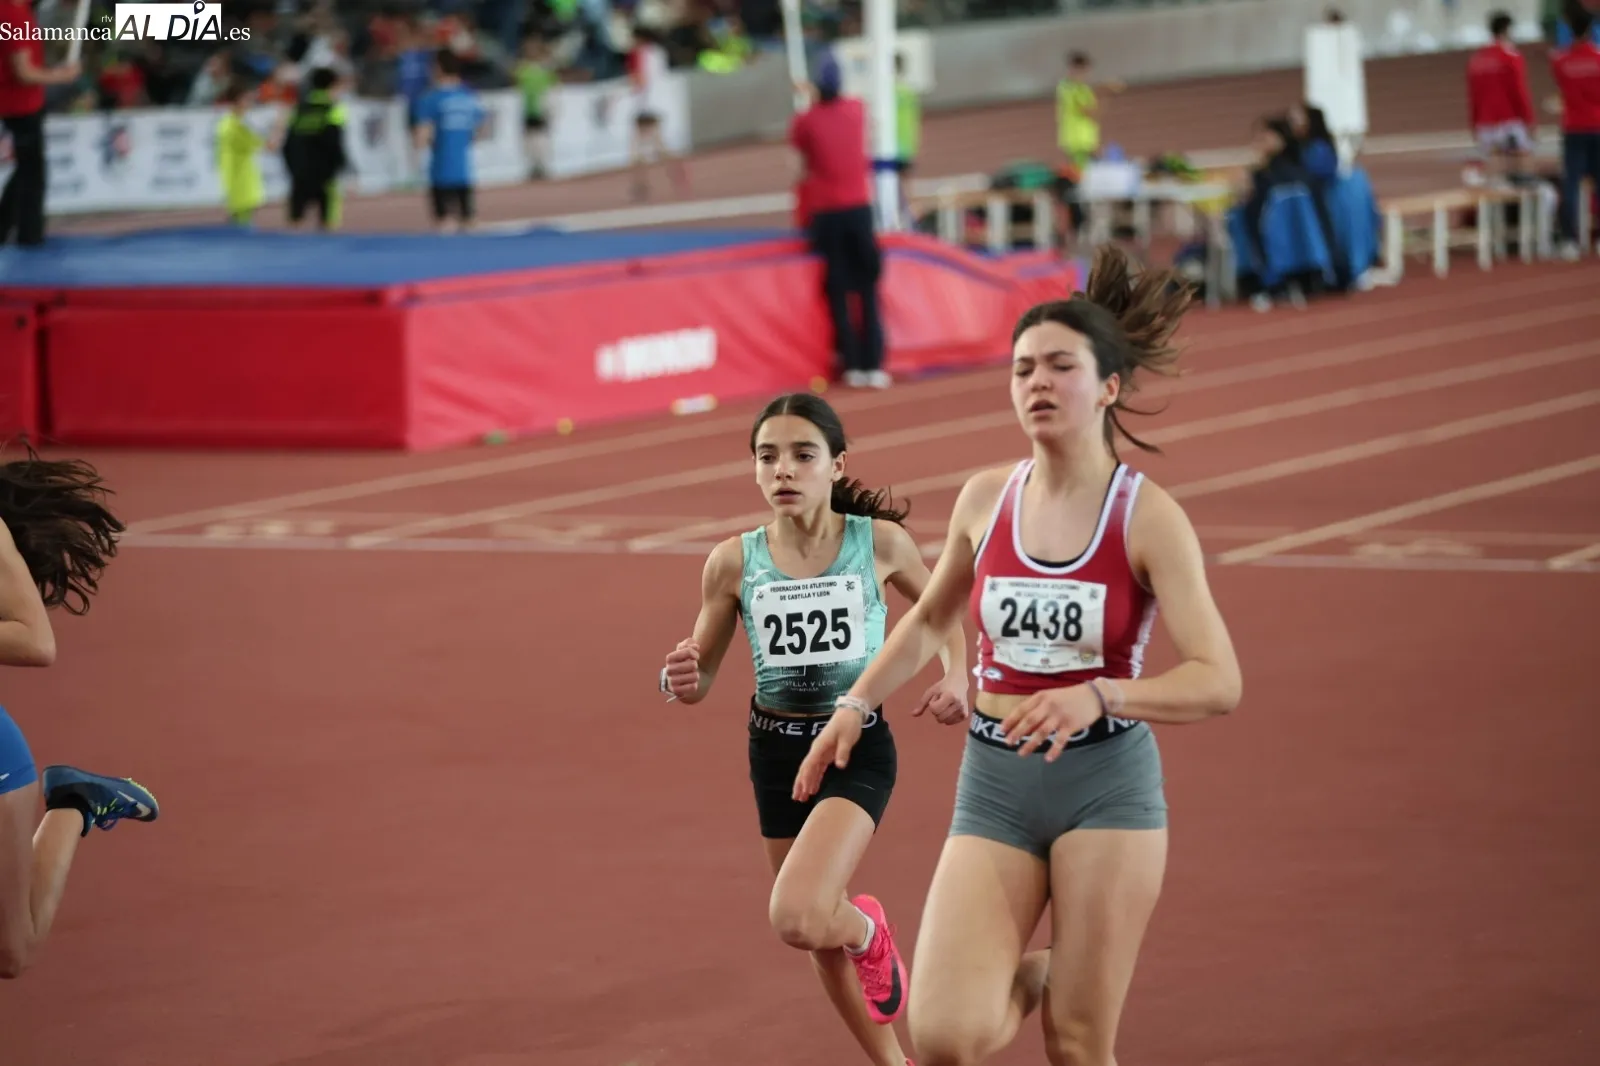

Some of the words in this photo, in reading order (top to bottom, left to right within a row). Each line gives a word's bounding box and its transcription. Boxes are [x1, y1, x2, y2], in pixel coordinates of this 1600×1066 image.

[788, 591, 812, 601] CASTILLA
[802, 582, 809, 590] DE
[810, 580, 838, 589] ATLETISMO
[763, 607, 852, 656] 2525
[1000, 597, 1082, 642] 2438
[750, 710, 806, 736] NIKE
